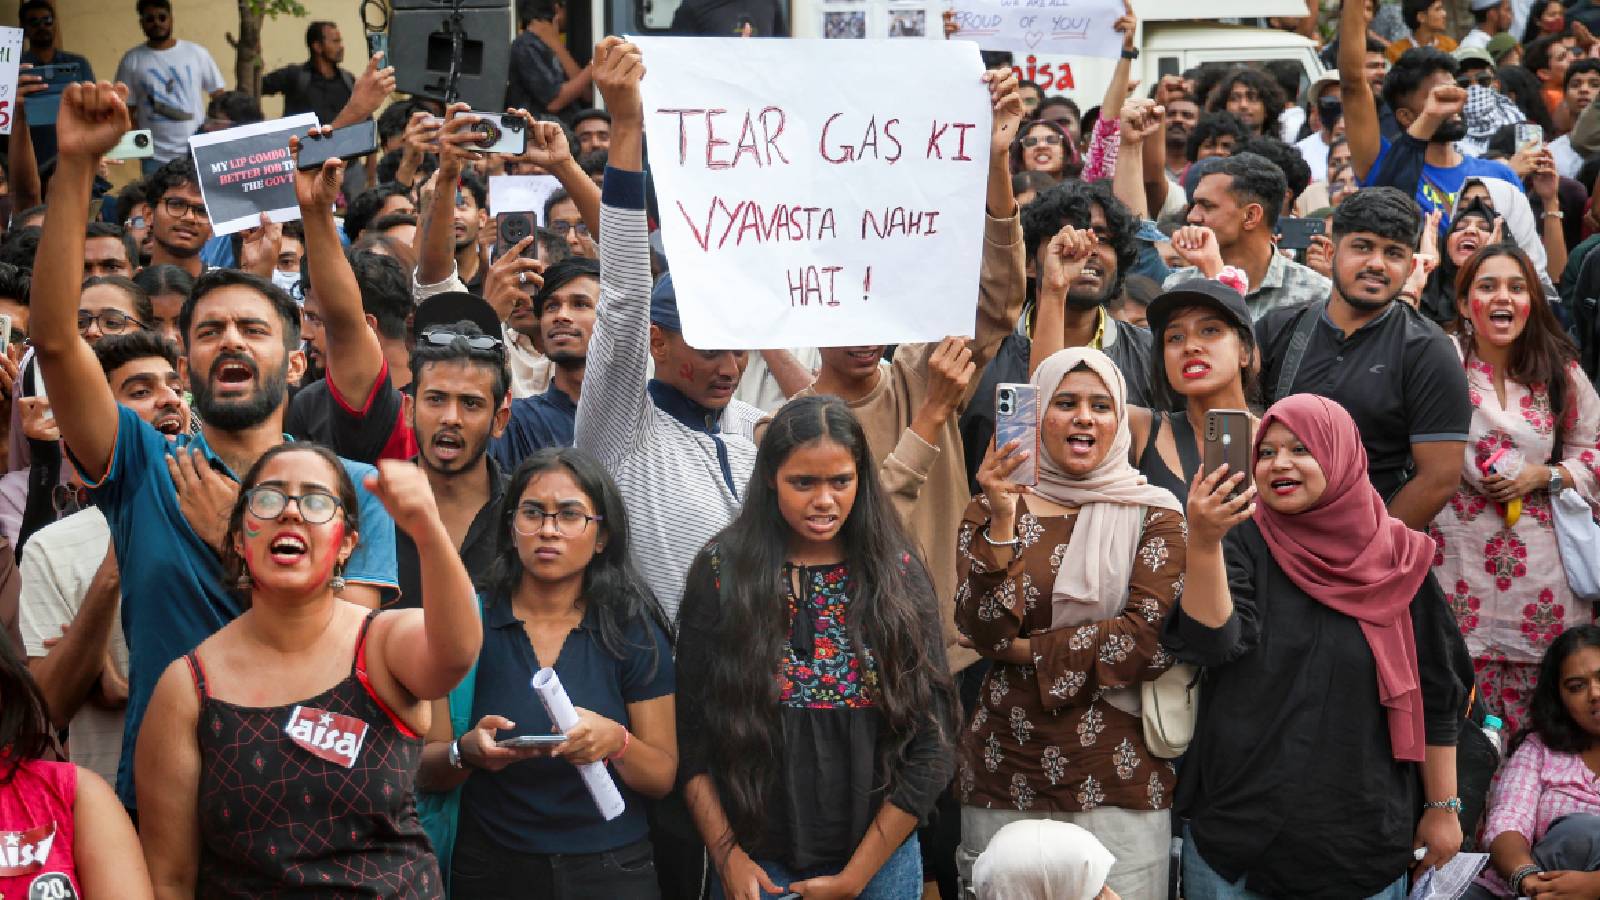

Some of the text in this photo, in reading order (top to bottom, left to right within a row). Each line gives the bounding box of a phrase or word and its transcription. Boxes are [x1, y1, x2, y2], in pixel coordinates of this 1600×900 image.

[955, 11, 1001, 29] PROUD
[1020, 16, 1037, 29] OF
[657, 106, 976, 169] TEAR GAS KI
[210, 161, 228, 173] MY
[229, 157, 247, 169] LIP
[248, 148, 286, 164] COMBO
[219, 167, 260, 186] BETTER
[263, 163, 282, 175] JOB
[242, 180, 264, 192] THE
[677, 196, 940, 252] VYAVASTA NAHI
[788, 265, 872, 307] HAI !
[291, 715, 356, 757] aisa
